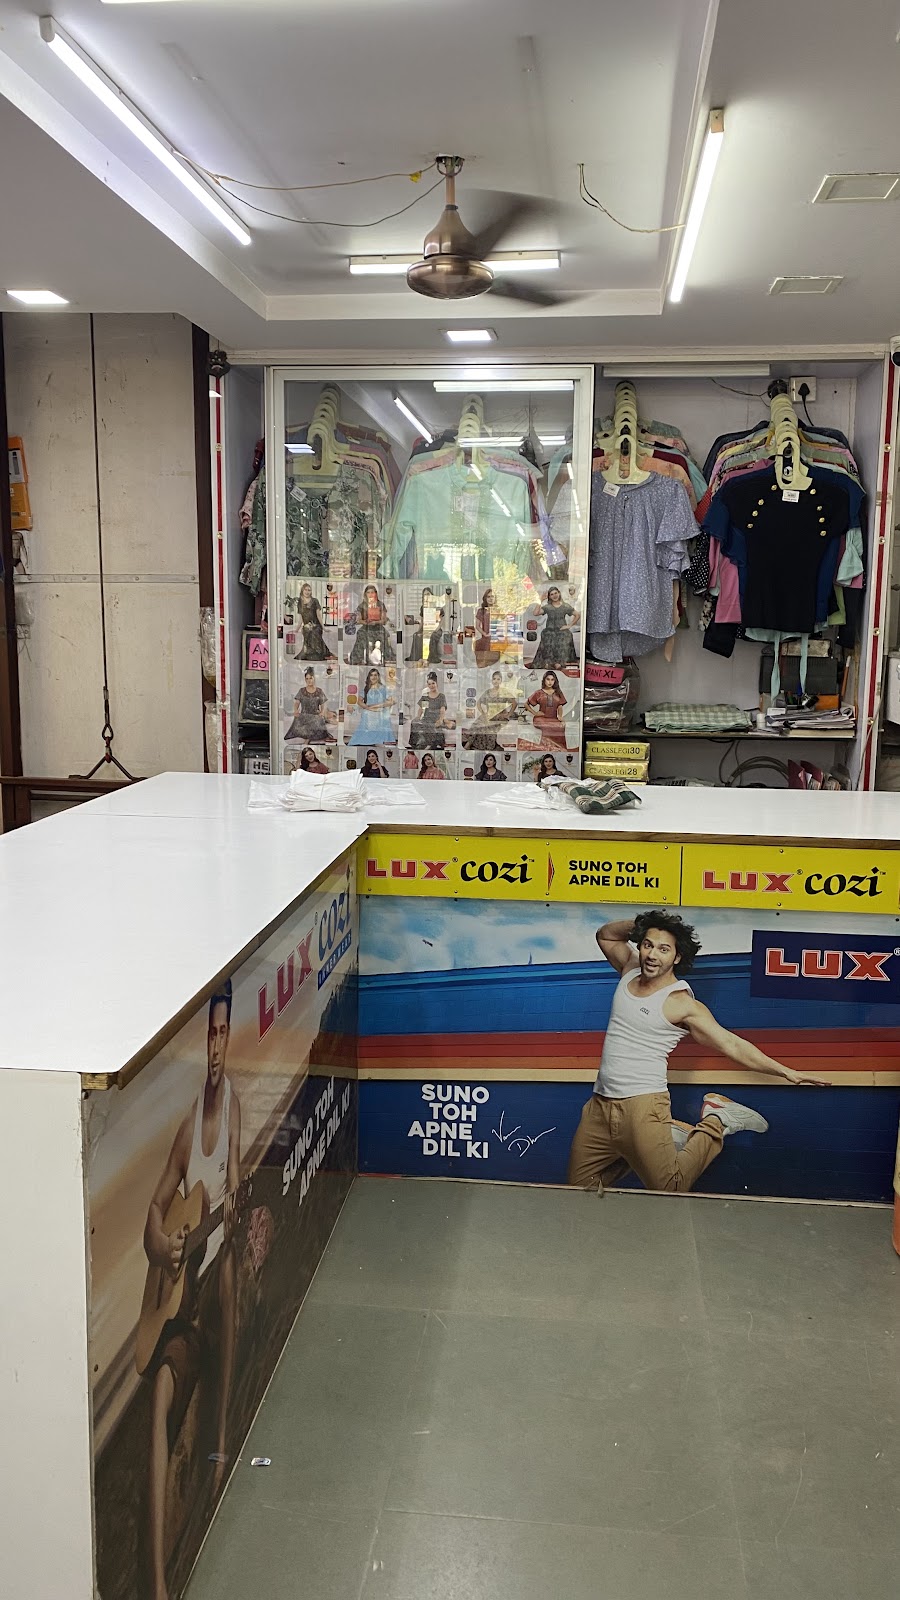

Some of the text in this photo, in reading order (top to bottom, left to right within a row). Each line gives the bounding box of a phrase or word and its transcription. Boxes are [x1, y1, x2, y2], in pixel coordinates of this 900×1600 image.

[251, 660, 269, 669] BO
[602, 669, 617, 679] XL
[253, 761, 270, 771] HE
[366, 854, 533, 884] LUX cozi
[569, 860, 648, 874] SUNO TOH
[569, 874, 660, 888] APNE DIL KI
[702, 866, 883, 897] LUX cozi
[765, 948, 894, 982] LUX
[258, 926, 315, 1045] LUX
[421, 1083, 490, 1104] SUNO
[429, 1102, 477, 1122] TOH
[282, 1075, 335, 1196] SUNO TOH
[407, 1120, 473, 1141] APNE
[298, 1082, 351, 1207] APNE DIL KI
[422, 1138, 489, 1159] DIL KI
